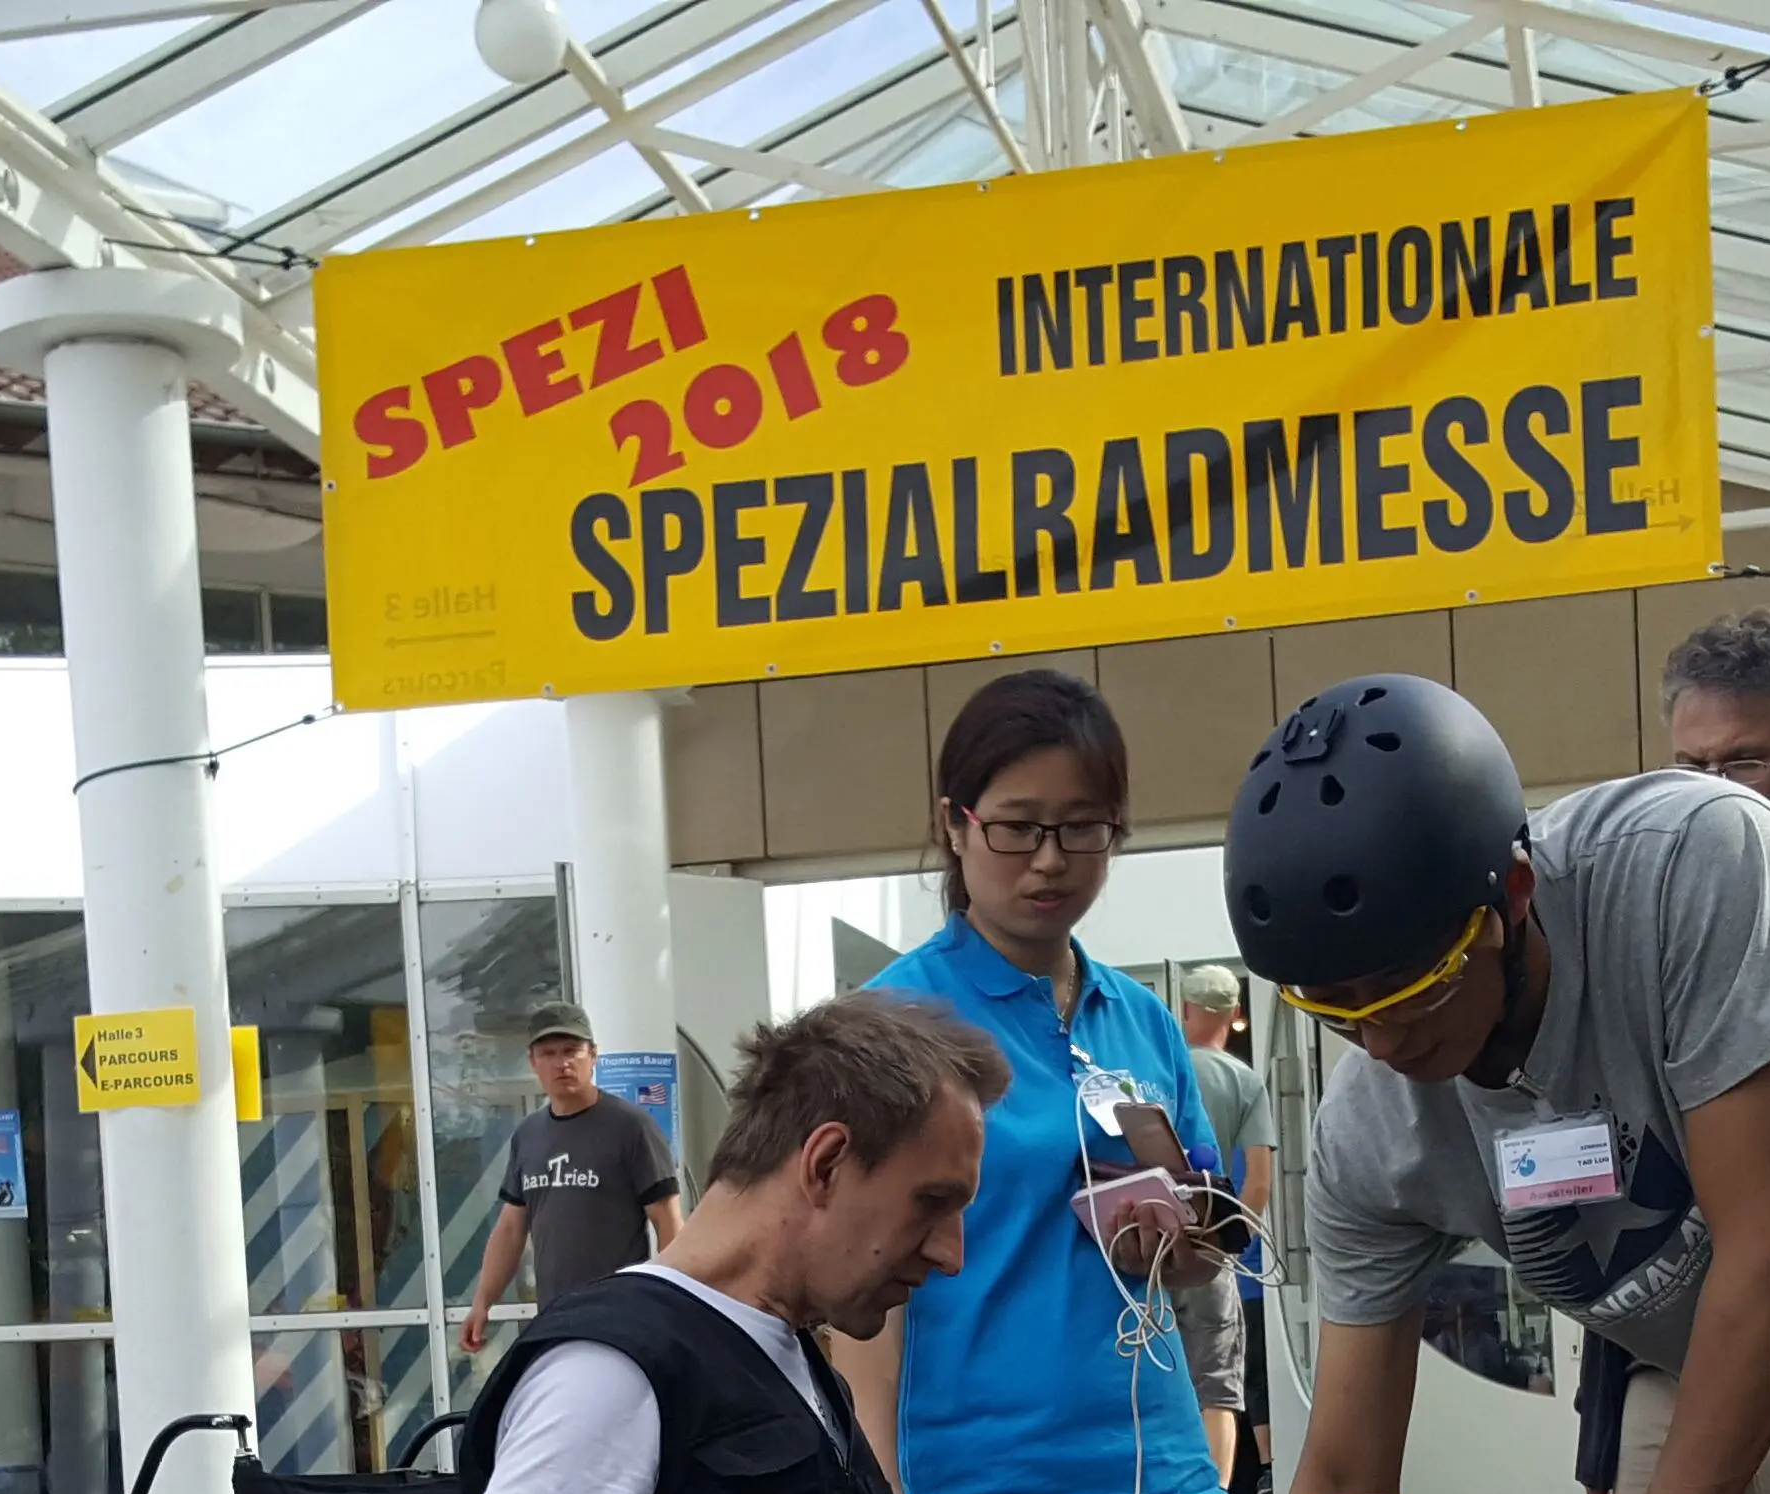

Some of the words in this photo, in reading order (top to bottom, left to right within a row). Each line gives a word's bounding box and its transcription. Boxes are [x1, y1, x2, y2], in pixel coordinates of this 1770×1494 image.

[996, 196, 1639, 377] INTERNATIONALE
[353, 264, 709, 480] SPEZI
[609, 293, 910, 489] 2018
[569, 375, 1648, 643] SPEZIALRADMESSE
[96, 1027, 133, 1043] Halle
[135, 1026, 143, 1040] 3
[99, 1049, 178, 1067] PARCOURS
[600, 1056, 641, 1067] Thomas
[643, 1055, 673, 1066] Bauer
[101, 1073, 194, 1092] E-PARCOURS
[1530, 1185, 1594, 1201] Aussteller
